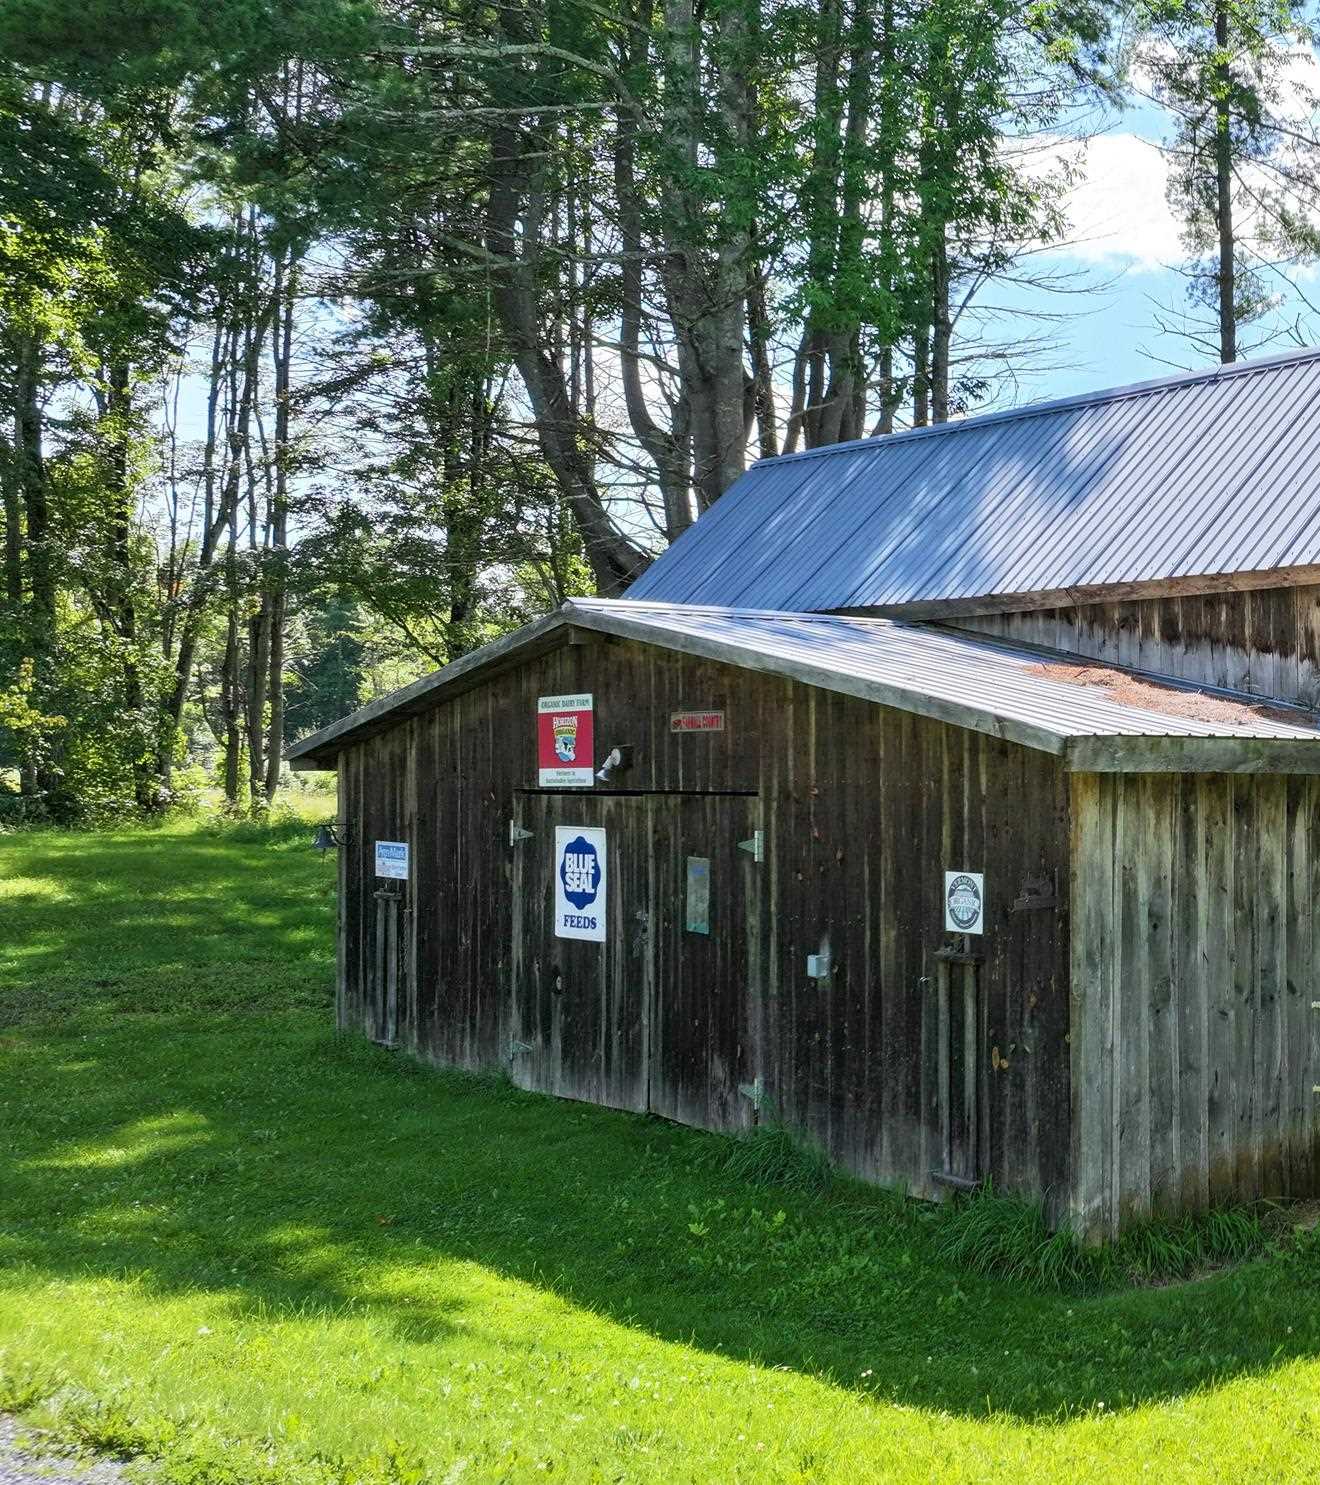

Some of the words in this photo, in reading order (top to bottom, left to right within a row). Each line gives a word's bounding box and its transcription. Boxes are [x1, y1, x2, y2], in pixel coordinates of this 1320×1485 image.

[565, 853, 596, 874] BLUE
[565, 873, 595, 894] SEAL
[563, 914, 597, 930] FEEDS
